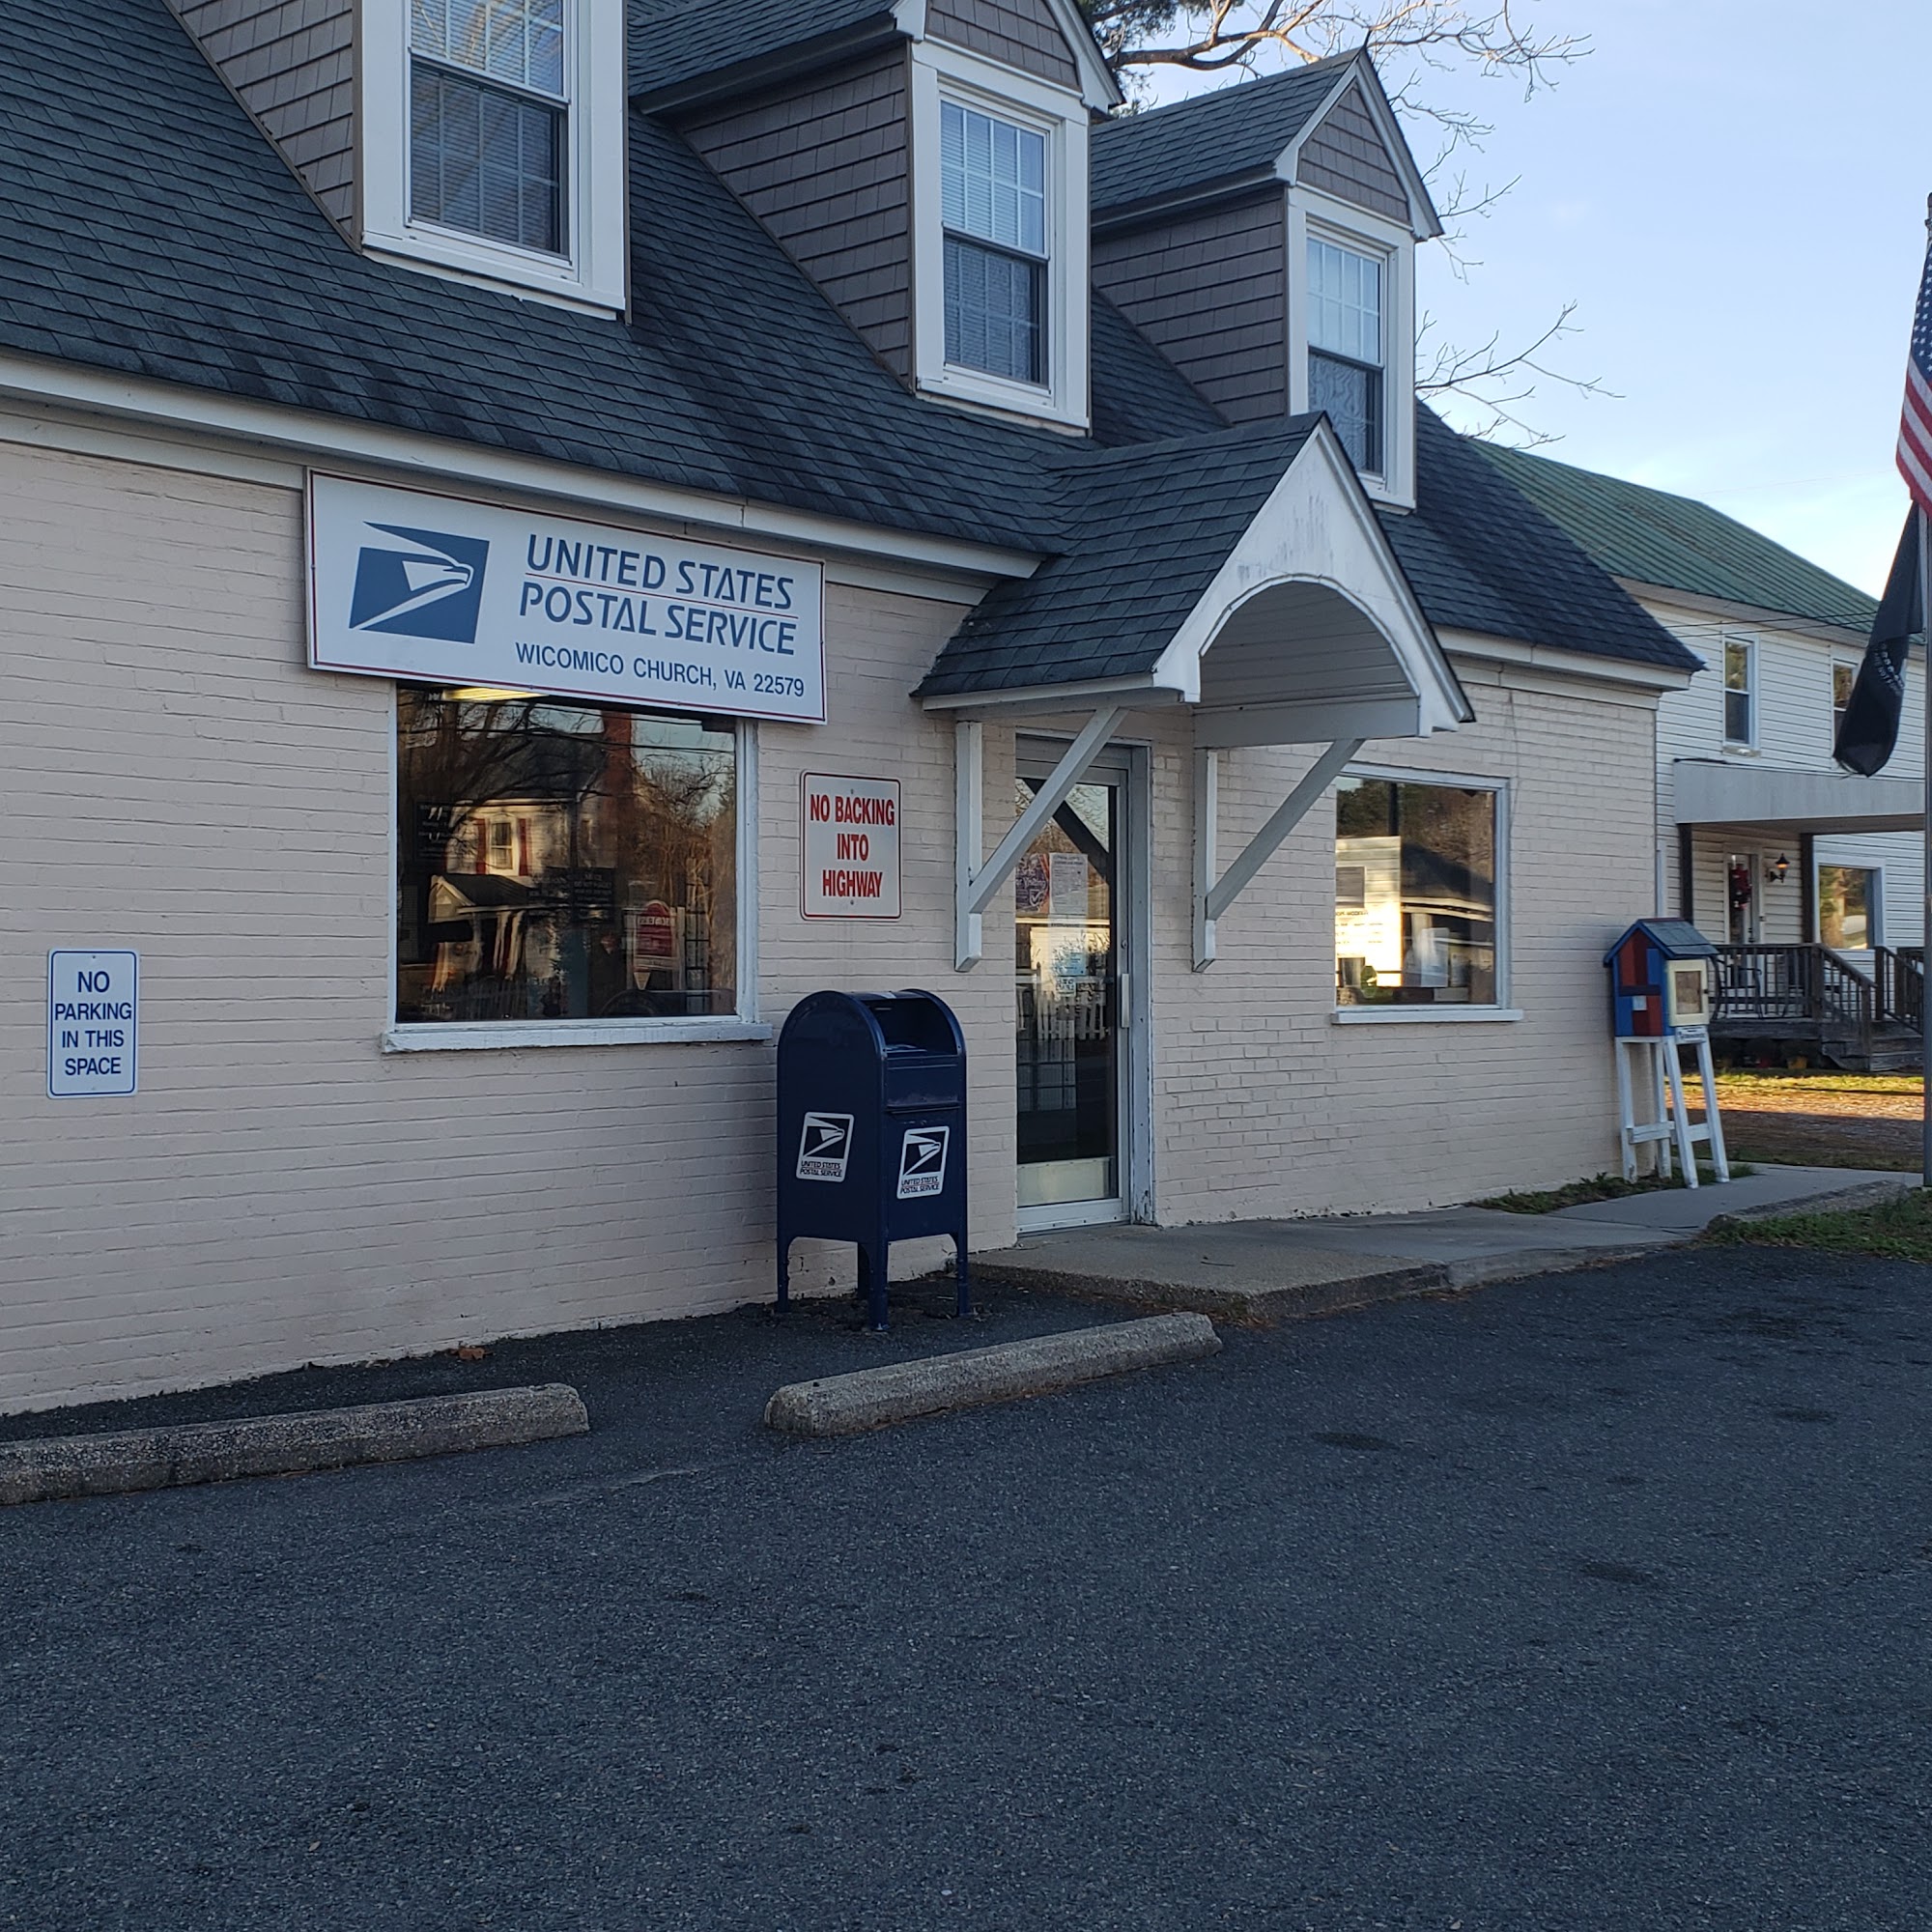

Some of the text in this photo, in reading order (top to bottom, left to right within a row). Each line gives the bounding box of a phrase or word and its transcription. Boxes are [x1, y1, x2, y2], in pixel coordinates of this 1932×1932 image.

[527, 532, 794, 611] UNITED STATES
[519, 581, 796, 656] POSTAL SERVICE
[515, 641, 805, 697] WICOMICO CHURCH, VA 22579
[810, 794, 895, 826] NO BACKING
[837, 833, 869, 862] INTO
[822, 869, 883, 898] HIGHWAY
[77, 970, 110, 993] NO
[55, 1002, 132, 1021] PARKING
[62, 1030, 125, 1048] IN THIS
[65, 1057, 122, 1076] SPACE
[801, 1160, 821, 1169] UNITED
[820, 1169, 842, 1178] SERVICE
[899, 1183, 940, 1194] POSTAL SERVICE
[900, 1176, 938, 1186] UNITED STATES
